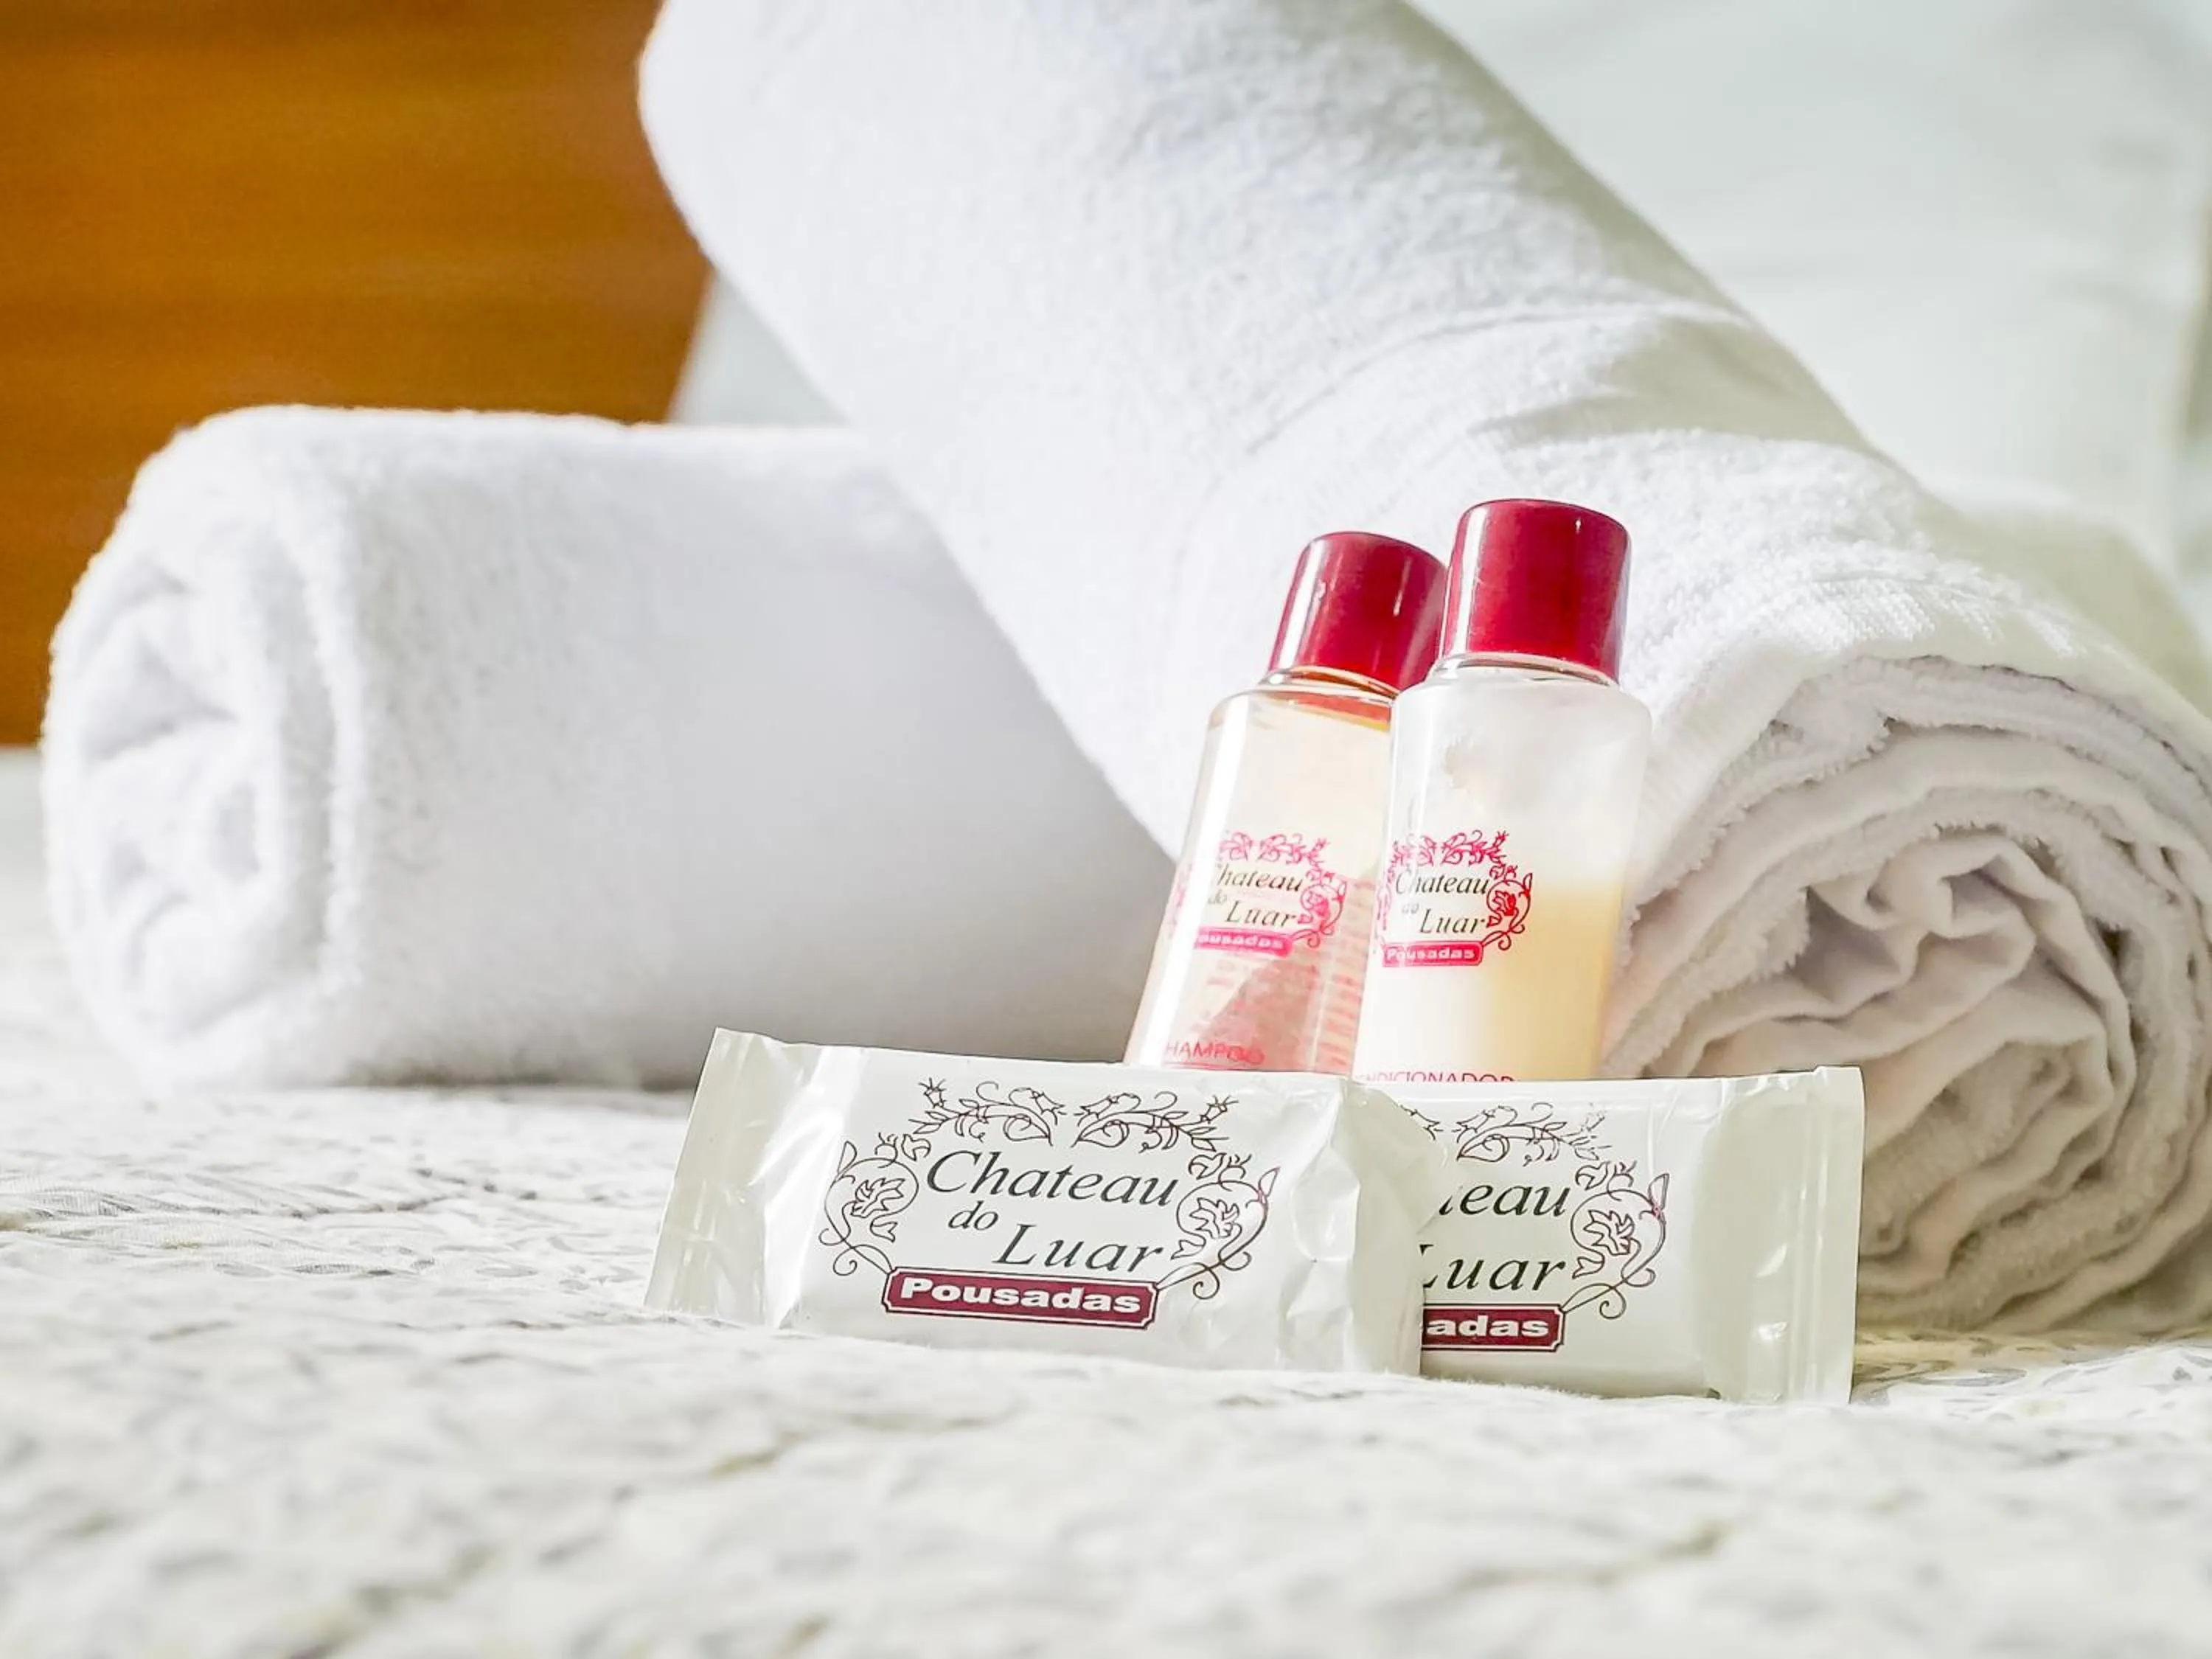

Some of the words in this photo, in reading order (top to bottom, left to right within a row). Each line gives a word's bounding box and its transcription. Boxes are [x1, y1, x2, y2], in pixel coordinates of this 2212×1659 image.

[1213, 863, 1303, 892] hateau
[1395, 863, 1489, 894] Chateau
[1224, 900, 1297, 928] Luar
[1419, 908, 1486, 933] Luar
[1164, 1040, 1265, 1066] HAMPOO
[927, 1150, 1178, 1206] Chateau
[947, 1201, 1000, 1231] do
[993, 1223, 1163, 1273] Luar
[900, 1277, 1141, 1313] Pousadas
[1425, 1314, 1550, 1338] adas
